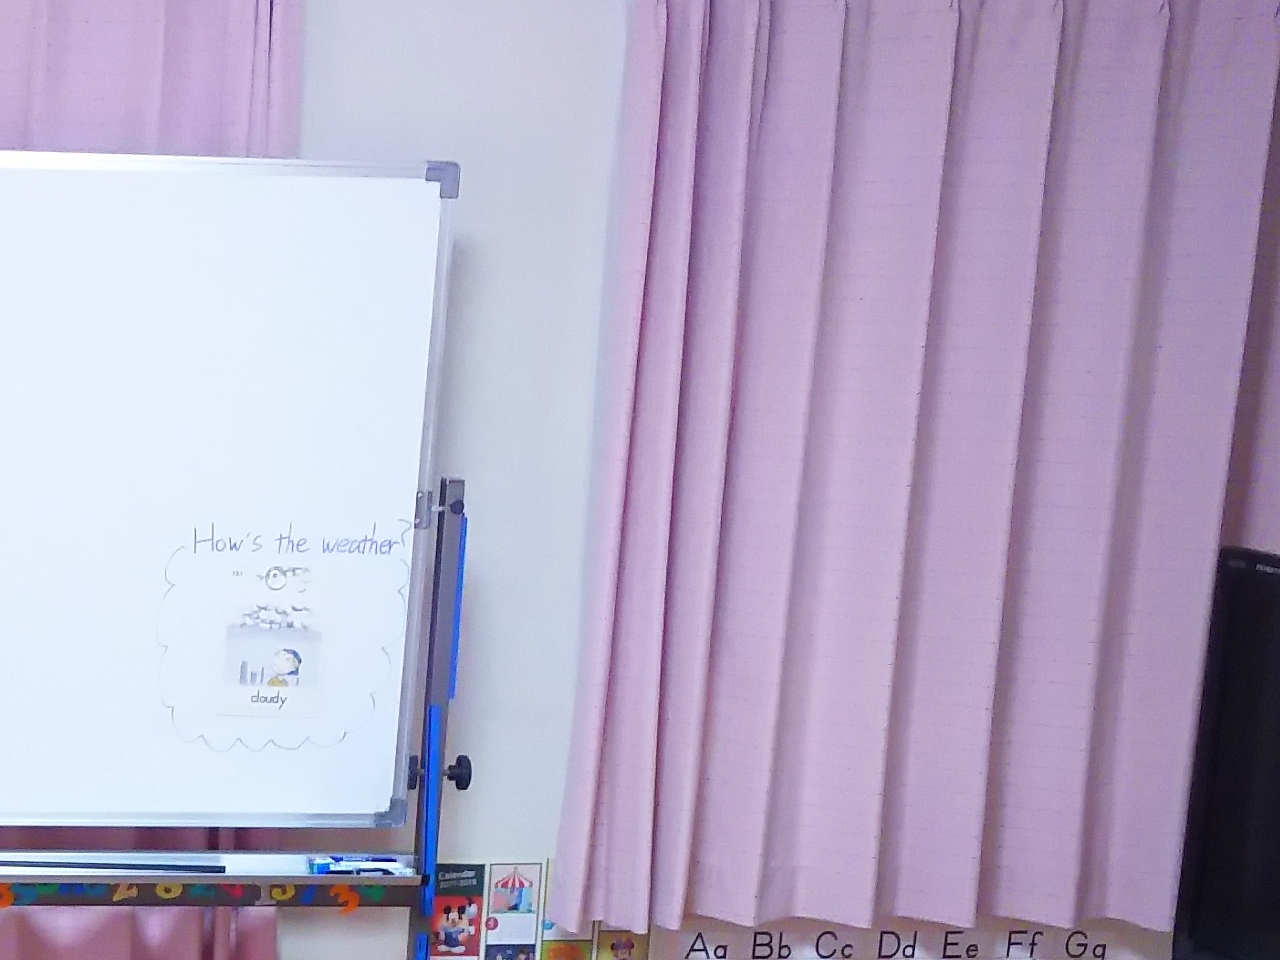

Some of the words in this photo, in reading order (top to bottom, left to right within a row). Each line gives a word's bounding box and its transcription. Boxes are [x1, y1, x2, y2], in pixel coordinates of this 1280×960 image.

[194, 521, 263, 554] How's
[275, 521, 310, 554] the
[250, 690, 288, 710] cloudy
[685, 931, 728, 960] Aa
[752, 931, 792, 960] Bb
[816, 931, 854, 960] Cc
[878, 931, 918, 960] Dd
[942, 931, 979, 959] Ee
[1006, 931, 1044, 959] Ff
